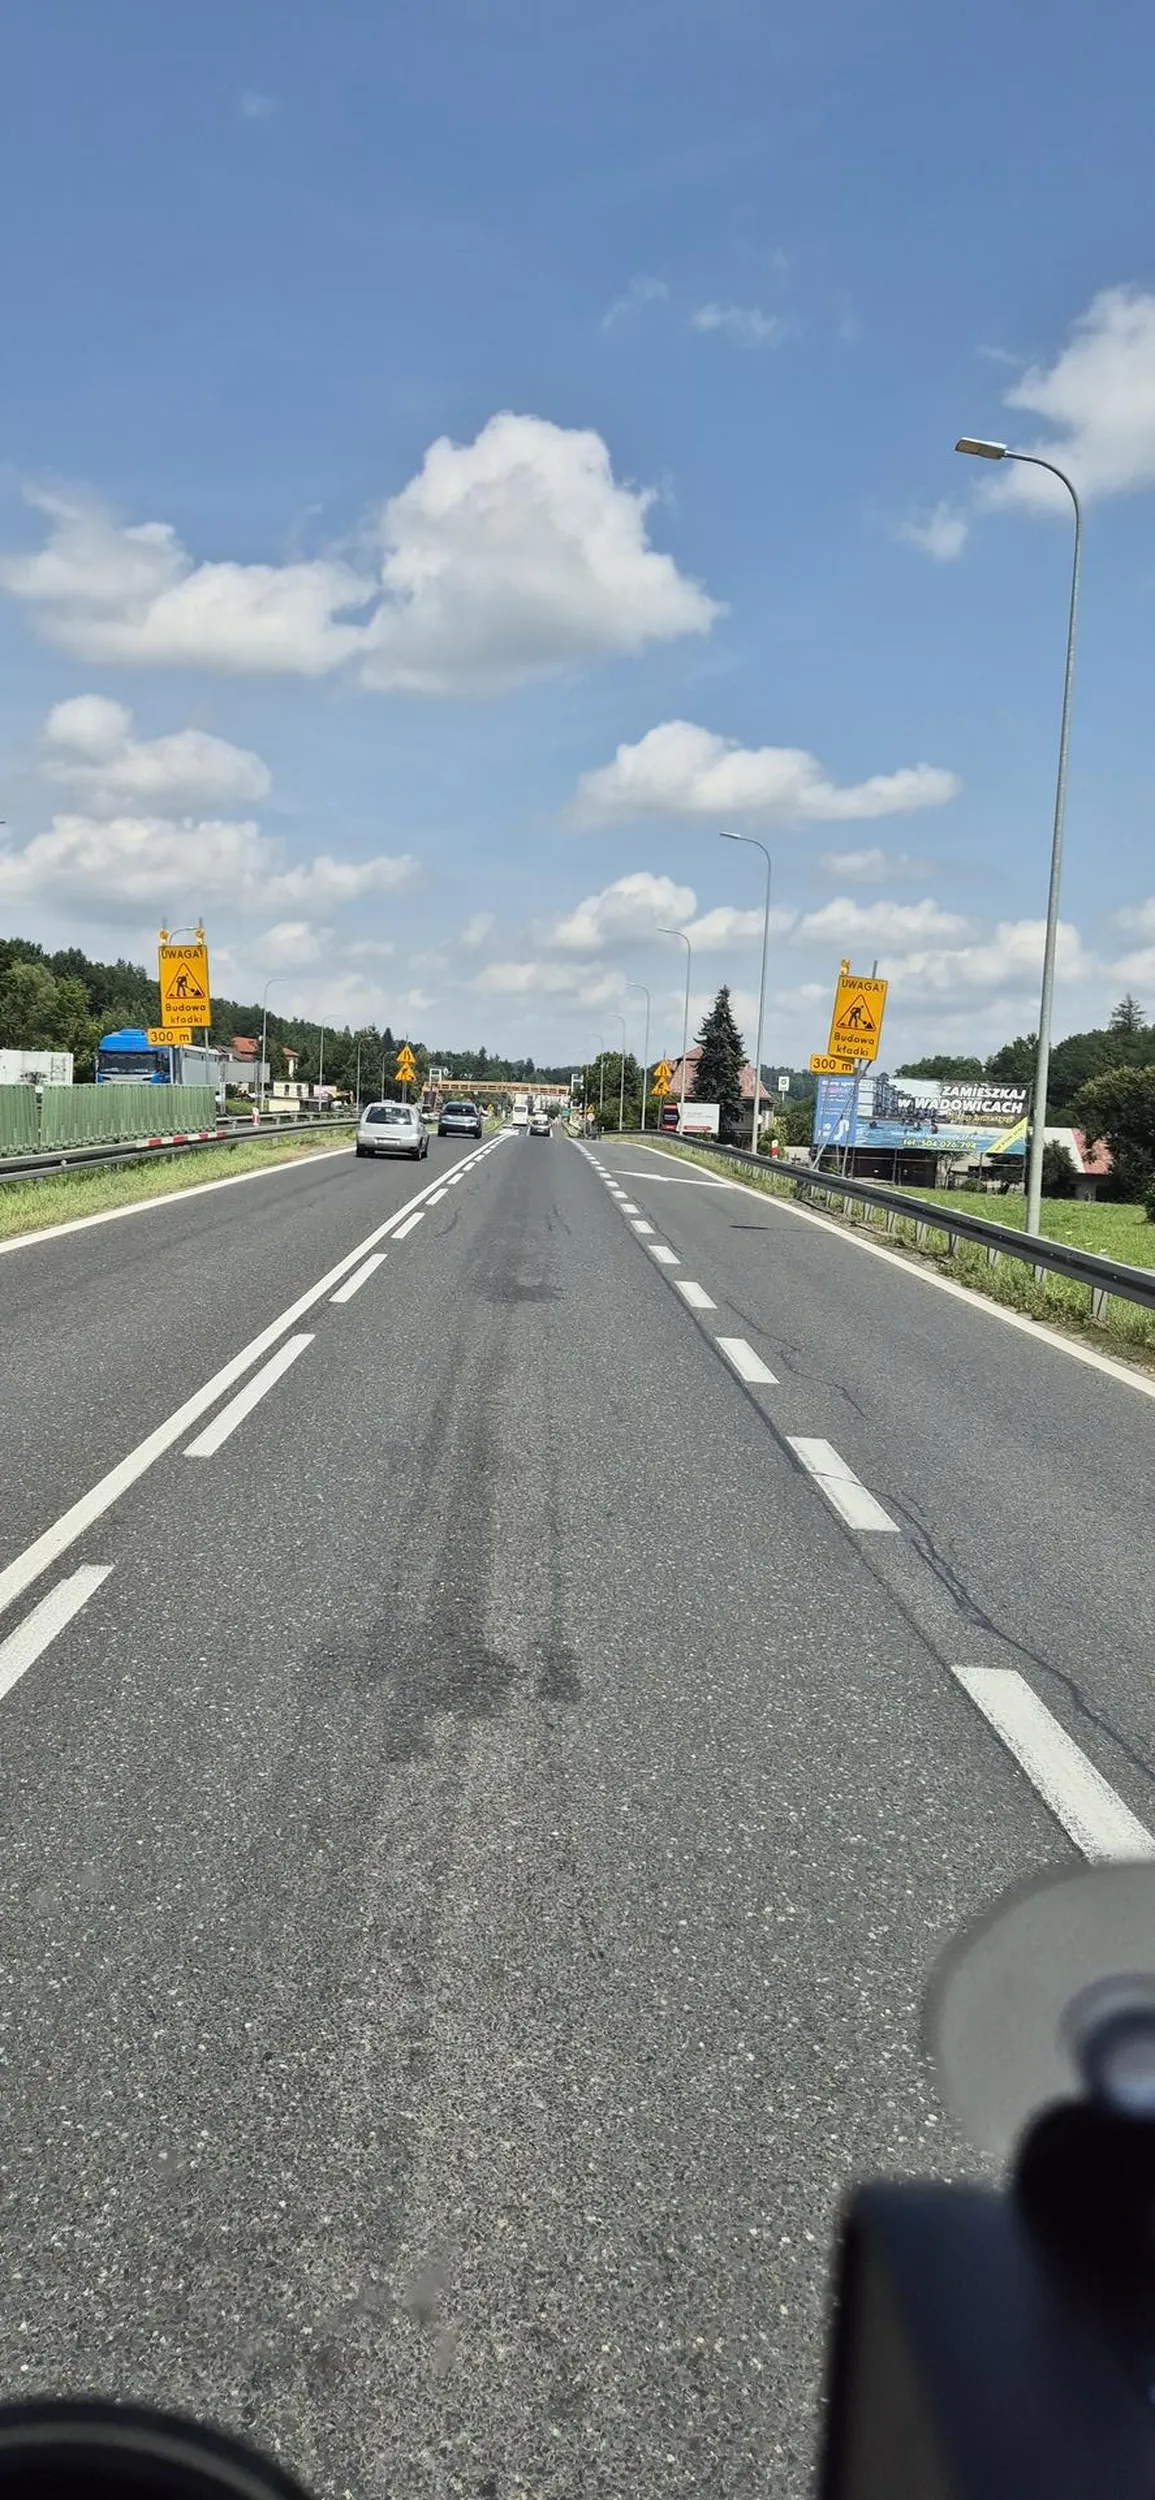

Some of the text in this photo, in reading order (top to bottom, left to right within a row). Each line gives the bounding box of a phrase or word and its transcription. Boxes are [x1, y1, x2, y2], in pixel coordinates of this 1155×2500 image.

[161, 949, 204, 959] UWAGA!
[841, 979, 884, 992] UWAGA!
[165, 1003, 206, 1012] Budowa
[170, 1015, 203, 1024] kładki
[151, 1031, 190, 1043] 300 m
[834, 1032, 875, 1045] Budowa
[836, 1045, 868, 1056] kładki
[813, 1058, 852, 1071] 300 m
[942, 1085, 1027, 1100] ZAMIESZKAJ
[898, 1097, 1023, 1114] w WADOWICACH
